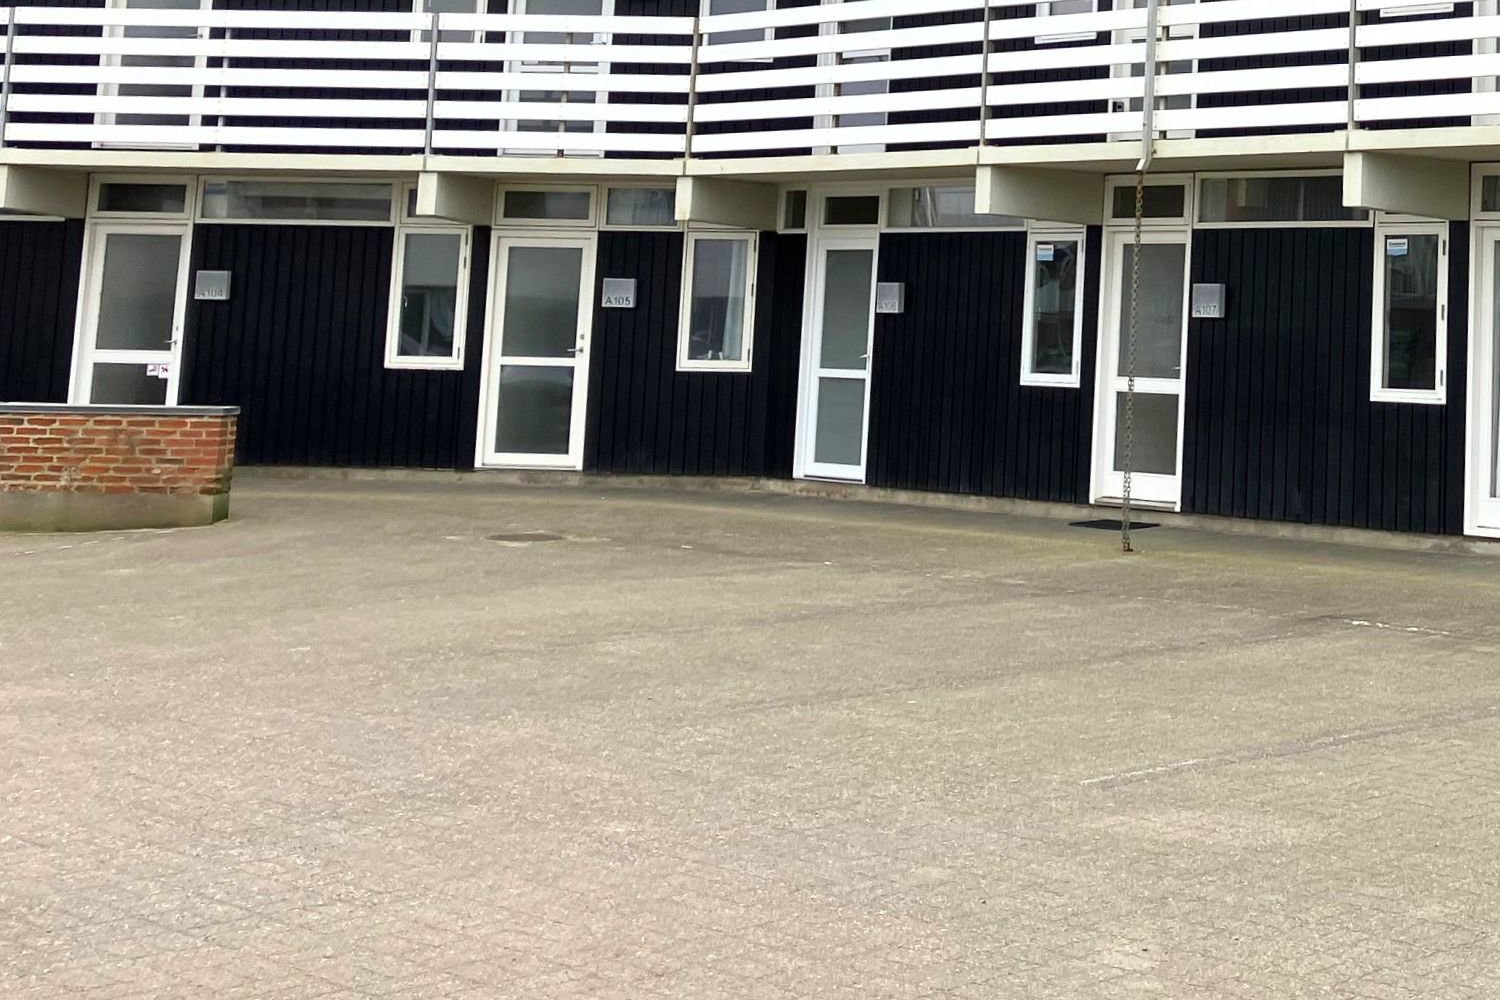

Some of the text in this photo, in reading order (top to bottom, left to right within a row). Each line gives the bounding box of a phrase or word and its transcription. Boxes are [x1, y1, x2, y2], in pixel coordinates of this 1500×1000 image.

[198, 287, 224, 298] A104
[604, 295, 631, 306] A105
[1194, 303, 1218, 316] A107
